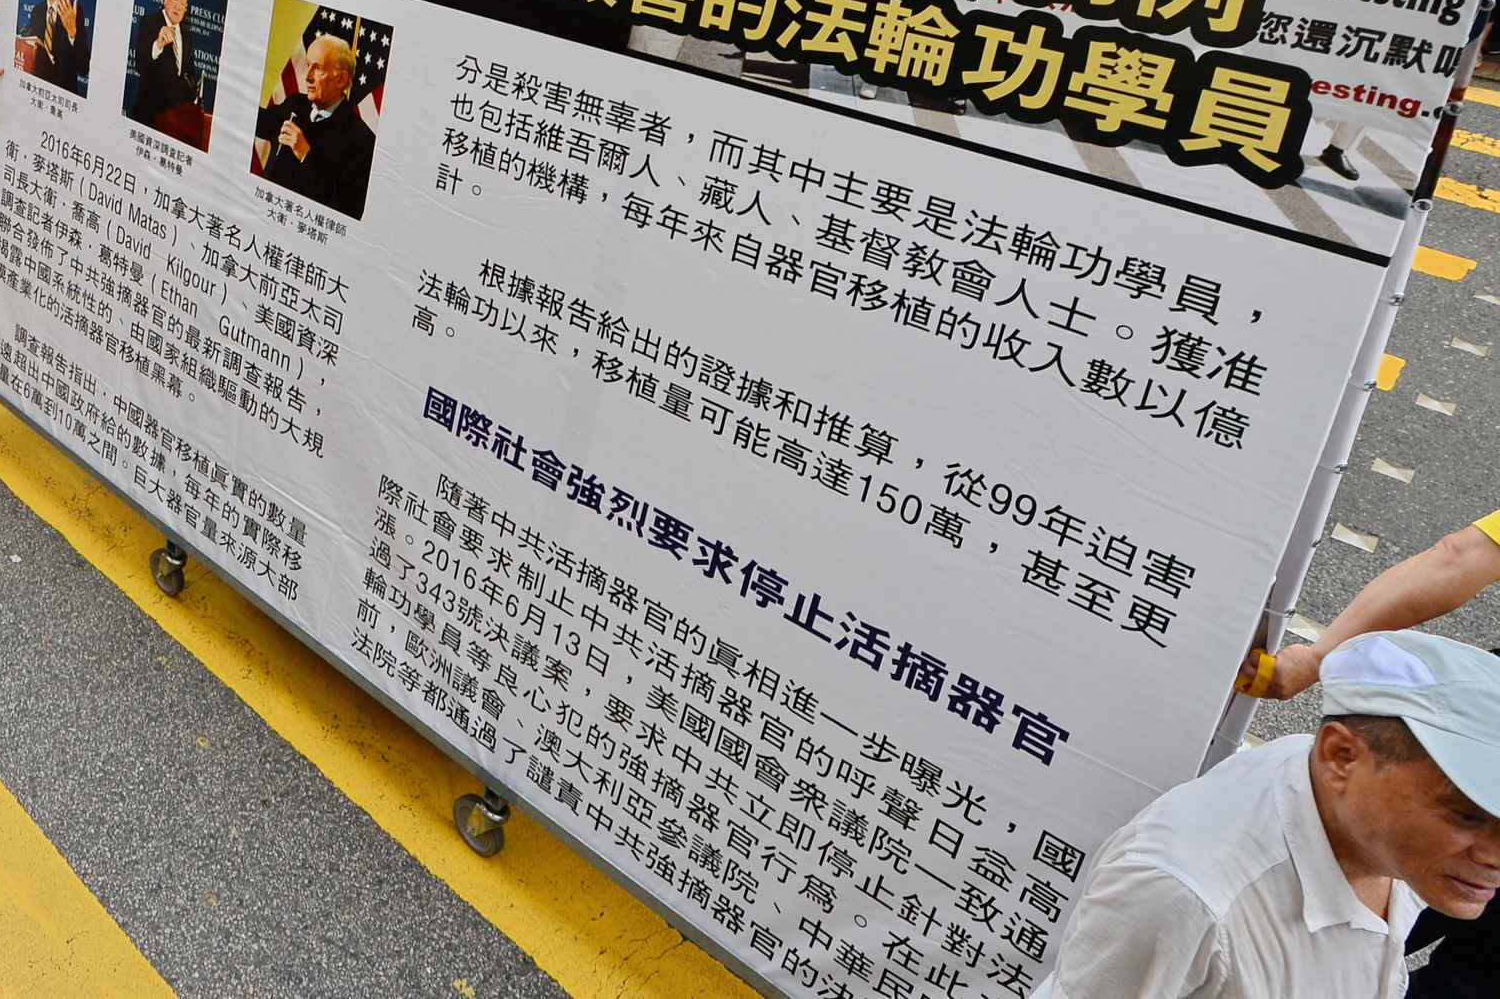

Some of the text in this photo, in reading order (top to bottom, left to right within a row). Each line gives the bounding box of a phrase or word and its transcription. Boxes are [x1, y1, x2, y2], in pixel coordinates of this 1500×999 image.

[190, 5, 212, 19] PRESS
[1311, 78, 1445, 120] esting.
[129, 129, 193, 167] 美國資深調查記者
[435, 162, 483, 198] 計。
[254, 185, 348, 238] 加拿大著名人權律師
[411, 303, 457, 339] 高。
[478, 258, 1197, 600] 根據報告給出的證據和推算，從99年迫害
[423, 386, 1070, 767] 國際社會強烈要求停止活摘器官
[377, 474, 1070, 924] 際社會要求制止中共活摘器官的呼聲日益高
[356, 596, 935, 999] 前，歐洲議會、澳大利亞參議院、中華民
